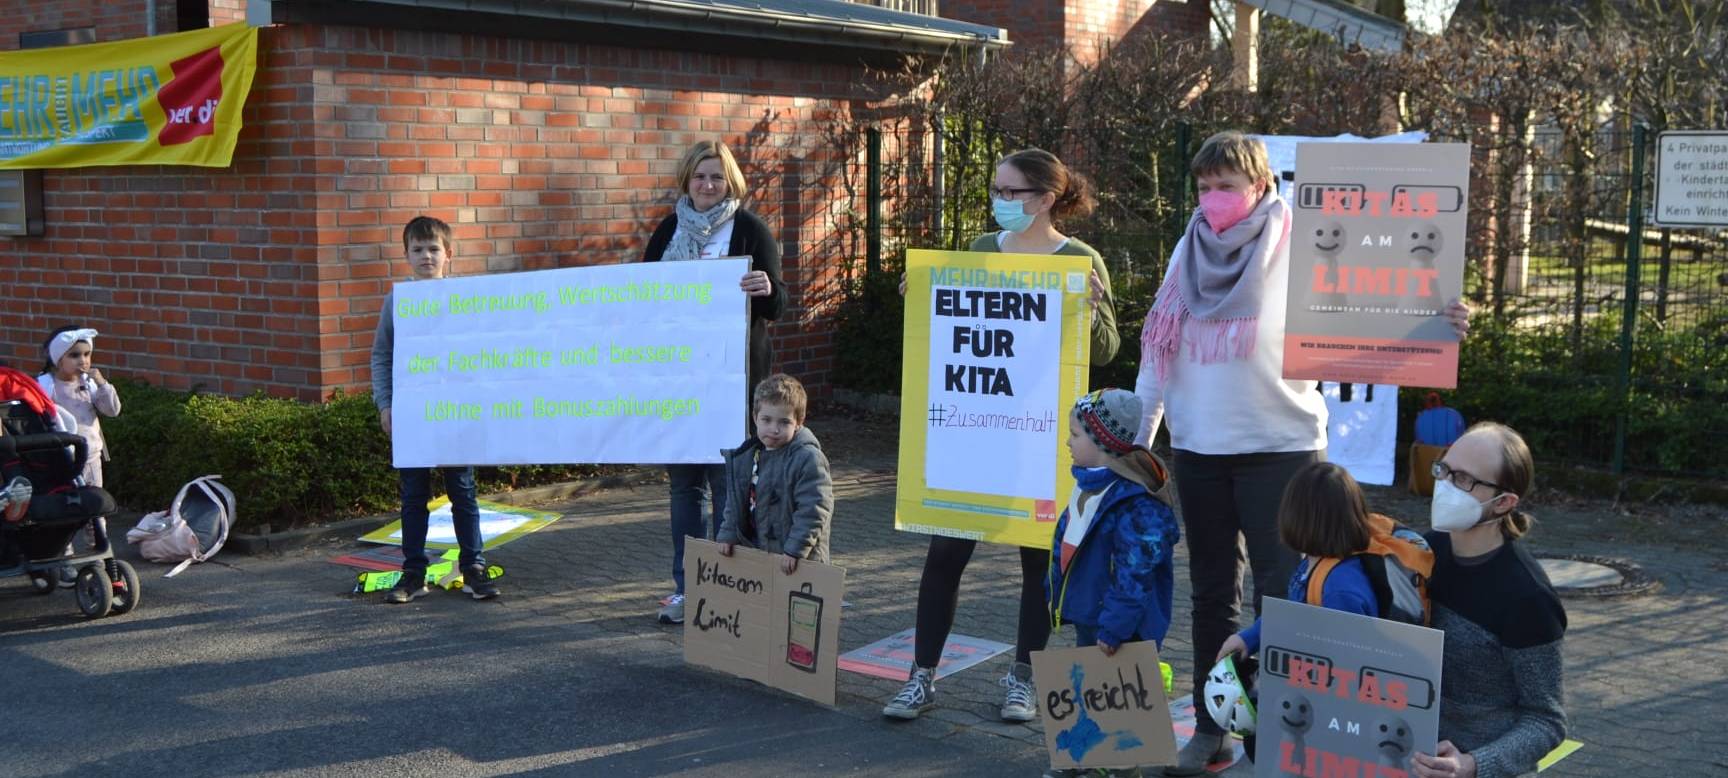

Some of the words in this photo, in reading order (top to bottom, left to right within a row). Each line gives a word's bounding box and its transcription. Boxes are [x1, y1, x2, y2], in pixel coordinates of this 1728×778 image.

[1667, 143, 1674, 152] 4
[1674, 160, 1693, 170] der
[1321, 190, 1440, 219] KITAS
[1666, 205, 1690, 216] Kein
[930, 265, 988, 287] MEHR
[1000, 270, 1061, 290] MEHR
[1311, 263, 1440, 298] LIMIT
[398, 297, 441, 319] Gute
[558, 281, 713, 305] Wertschätzung
[935, 288, 1047, 322] ELTERN
[953, 323, 1015, 358] FÜR
[408, 354, 440, 374] der
[448, 346, 553, 372] Fachkräfte
[560, 345, 599, 366] und
[609, 343, 693, 364] bessere
[945, 364, 1014, 397] KITA
[425, 400, 483, 421] Löhne
[492, 399, 524, 418] mit
[532, 396, 701, 422] Bonuszahlungen
[928, 402, 1057, 432] #Zusammenhalt
[693, 598, 741, 638] Limit
[1047, 688, 1075, 721] es
[1083, 663, 1153, 712] reicht
[1288, 658, 1408, 711] KITAS
